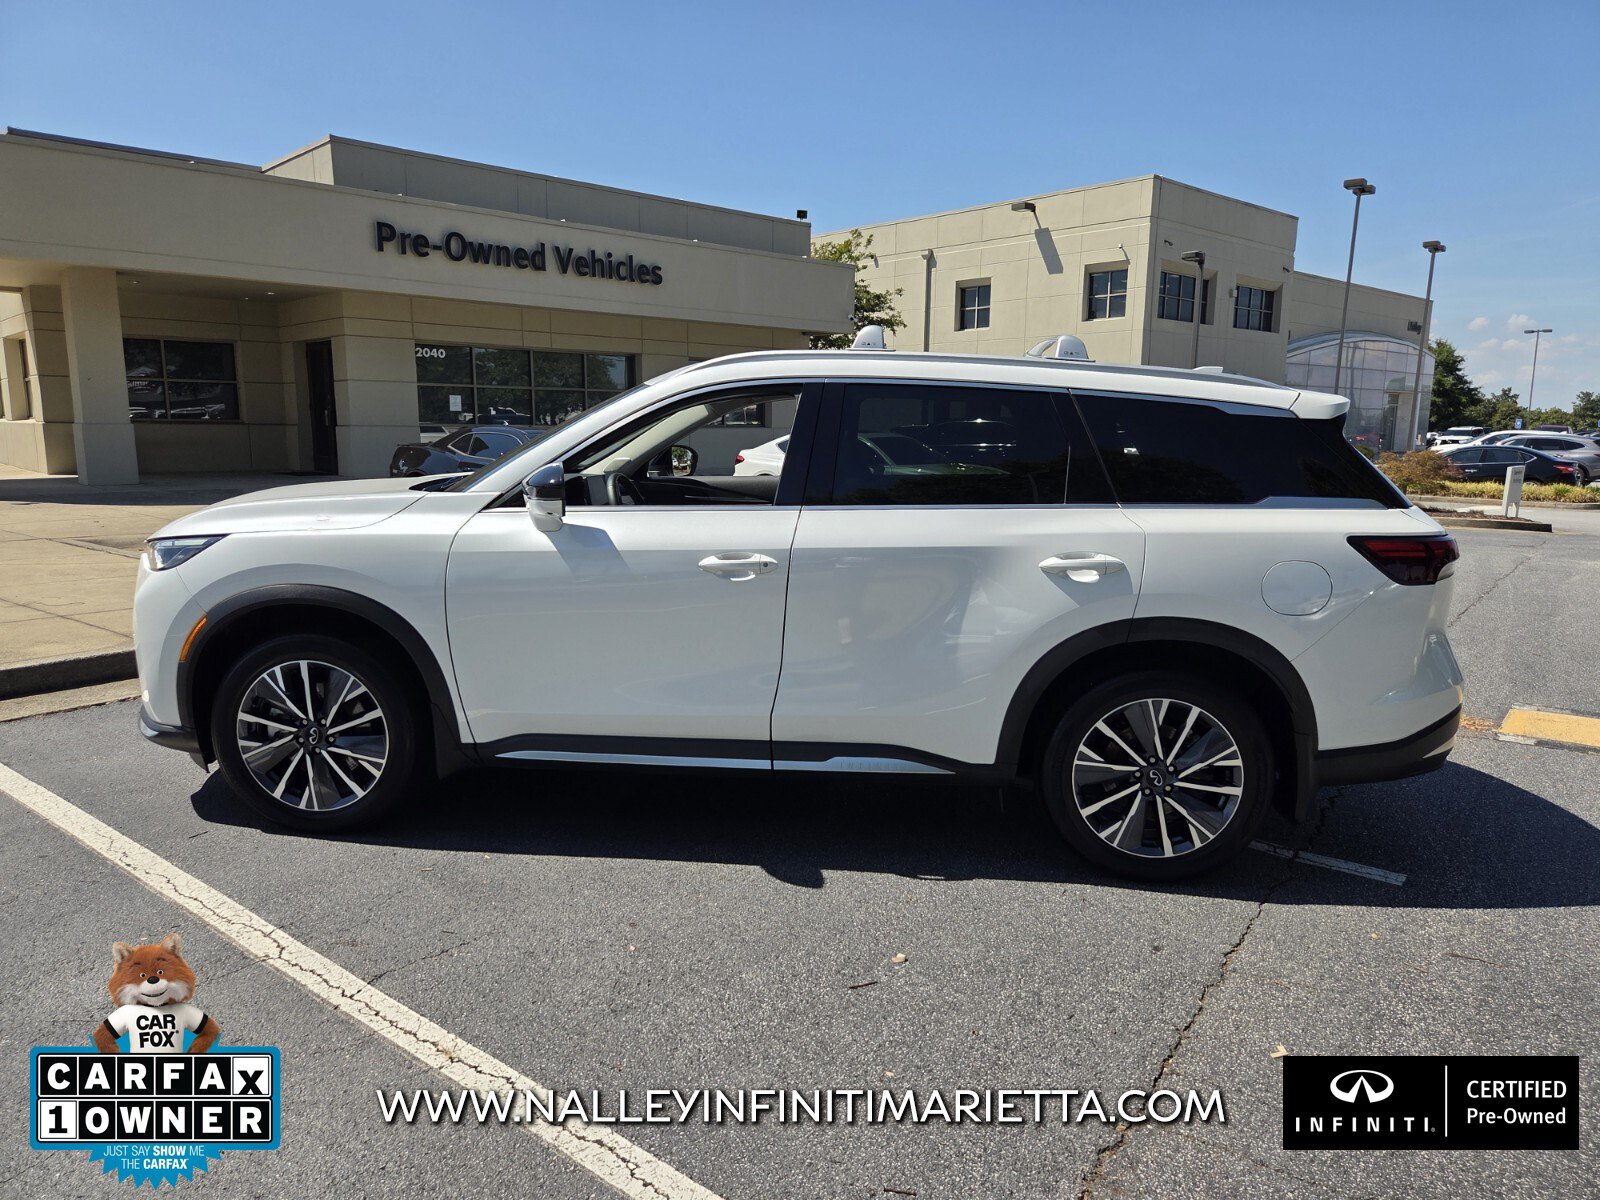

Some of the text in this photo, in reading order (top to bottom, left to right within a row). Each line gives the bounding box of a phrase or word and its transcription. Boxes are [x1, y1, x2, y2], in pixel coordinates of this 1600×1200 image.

[374, 221, 663, 285] Pre-Owned Vehicles
[415, 347, 446, 359] 2040
